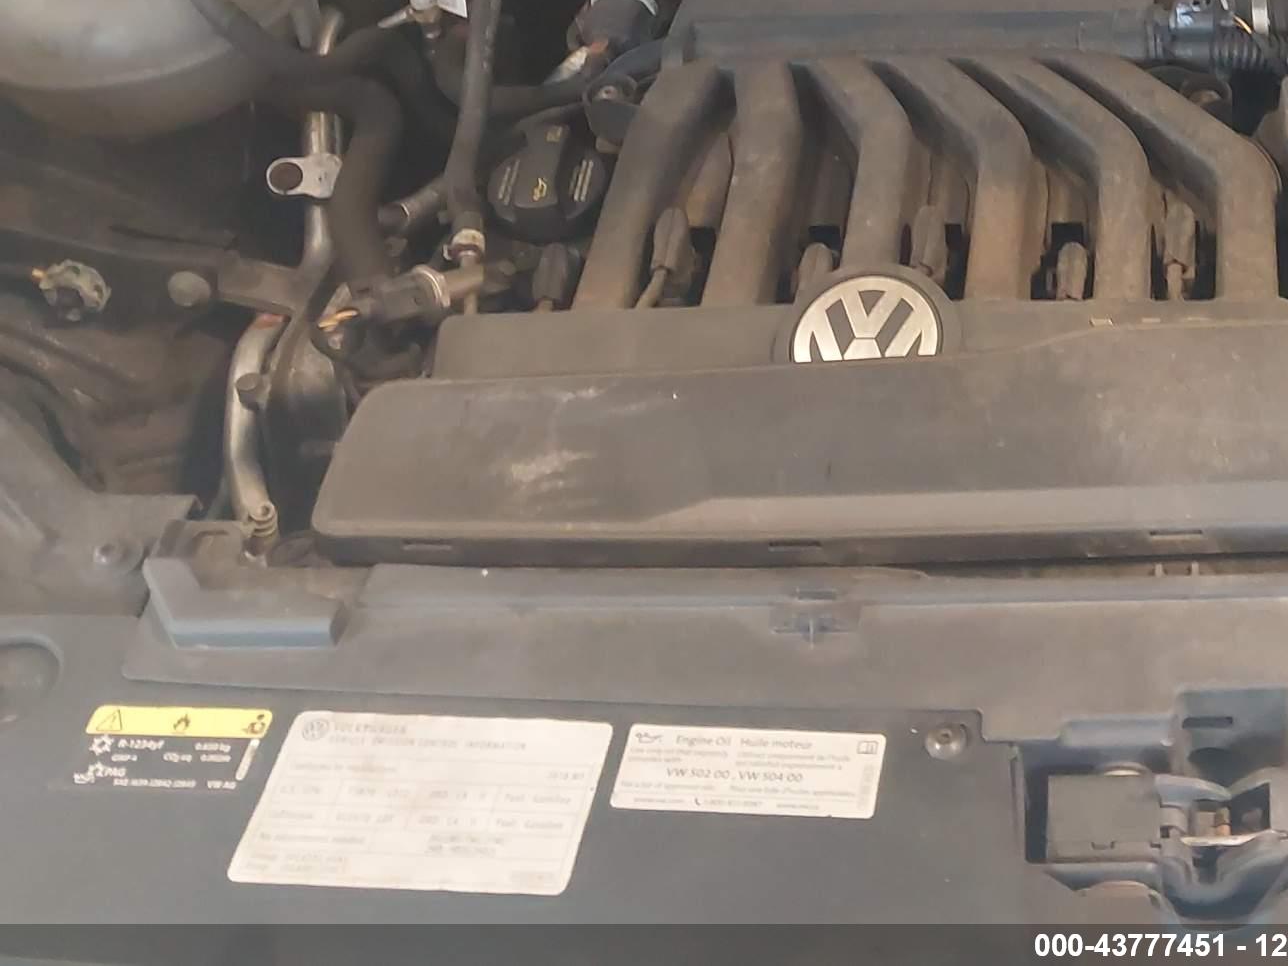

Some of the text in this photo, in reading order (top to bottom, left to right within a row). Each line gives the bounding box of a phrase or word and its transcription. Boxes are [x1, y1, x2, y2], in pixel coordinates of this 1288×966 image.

[676, 735, 732, 746] Engine Oil
[740, 738, 813, 750] Huile moteur
[666, 767, 688, 777] VW
[690, 768, 712, 779] 502
[738, 770, 759, 781] VW
[763, 771, 784, 781] 504
